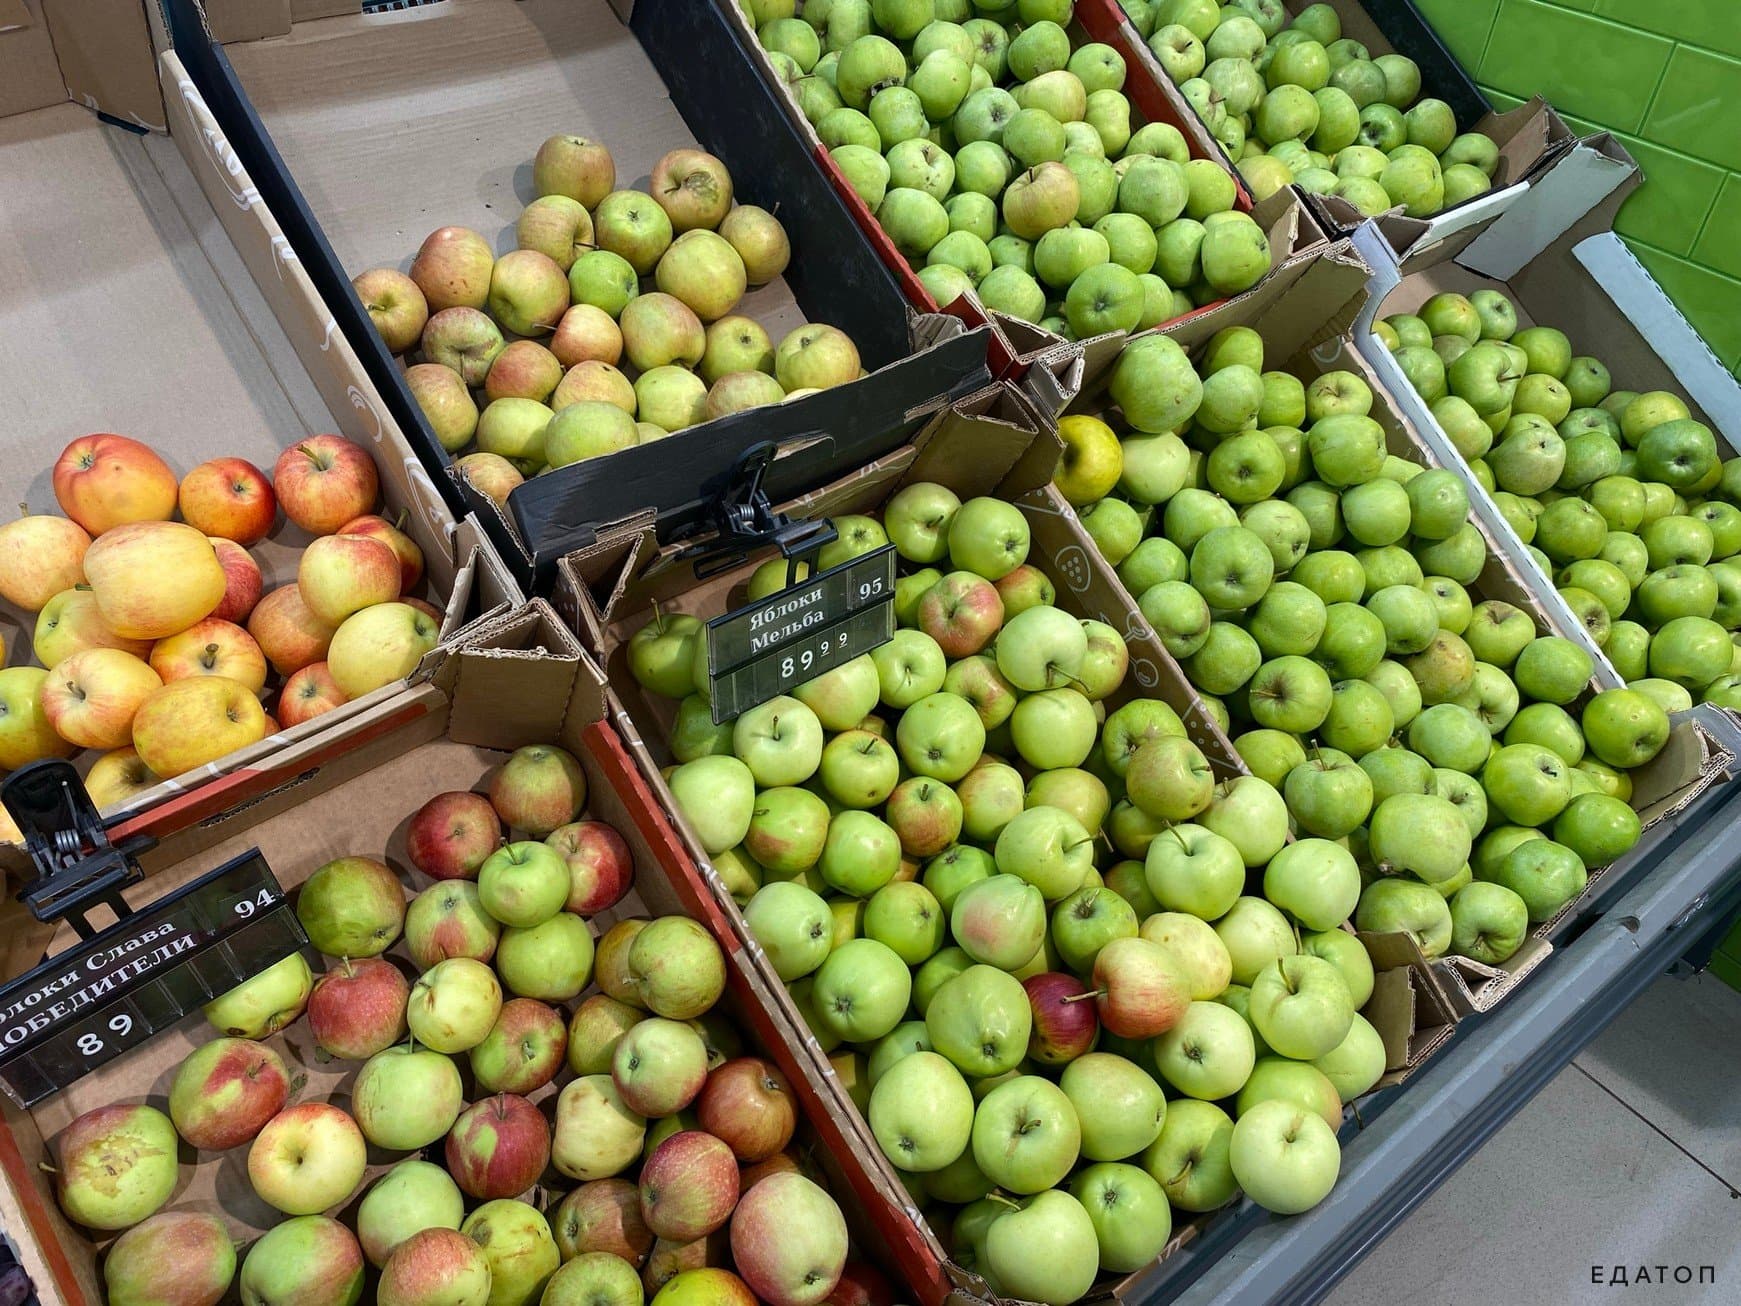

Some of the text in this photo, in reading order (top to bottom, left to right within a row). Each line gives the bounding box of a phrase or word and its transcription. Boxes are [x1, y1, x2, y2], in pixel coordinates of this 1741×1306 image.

[750, 588, 823, 632] Яблоки
[860, 577, 882, 600] 95
[751, 608, 825, 653] Мельба
[234, 888, 276, 919] 94
[86, 922, 177, 971] Слава
[76, 1014, 133, 1056] 89
